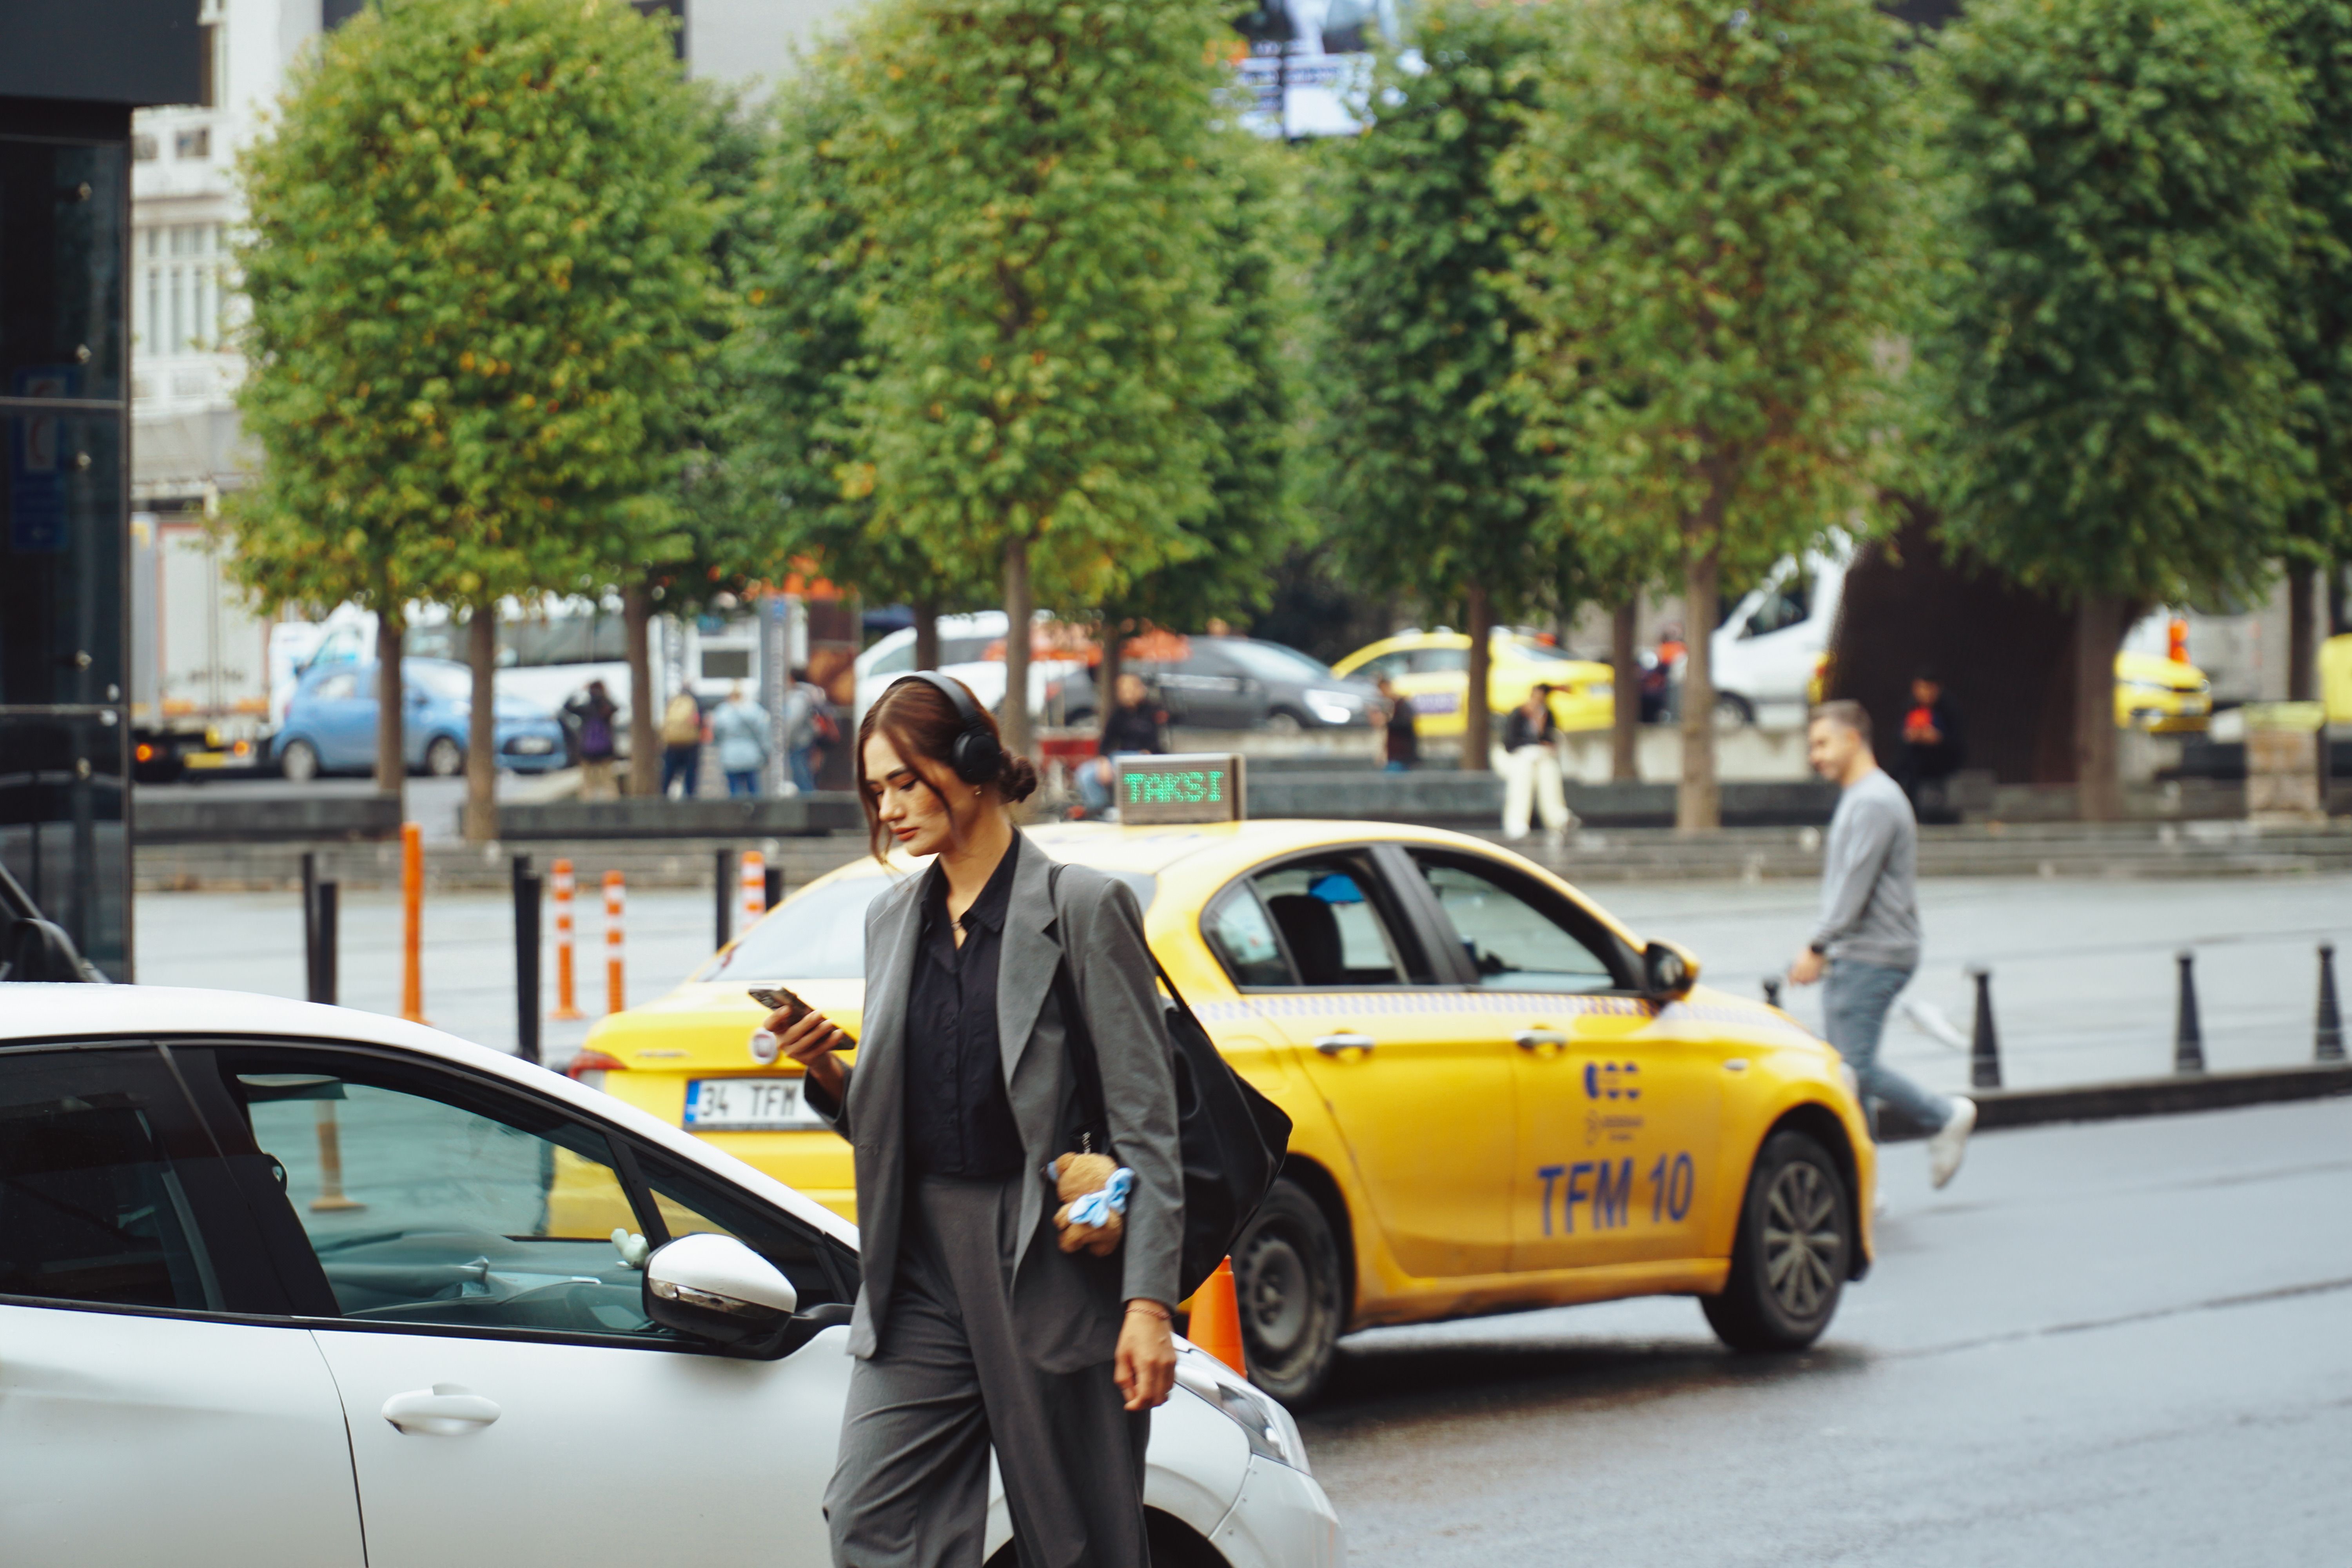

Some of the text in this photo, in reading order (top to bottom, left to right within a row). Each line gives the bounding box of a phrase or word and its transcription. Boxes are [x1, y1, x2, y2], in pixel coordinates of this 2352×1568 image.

[700, 1085, 797, 1116] 34 TFM
[1536, 1151, 1695, 1236] TFM 10
